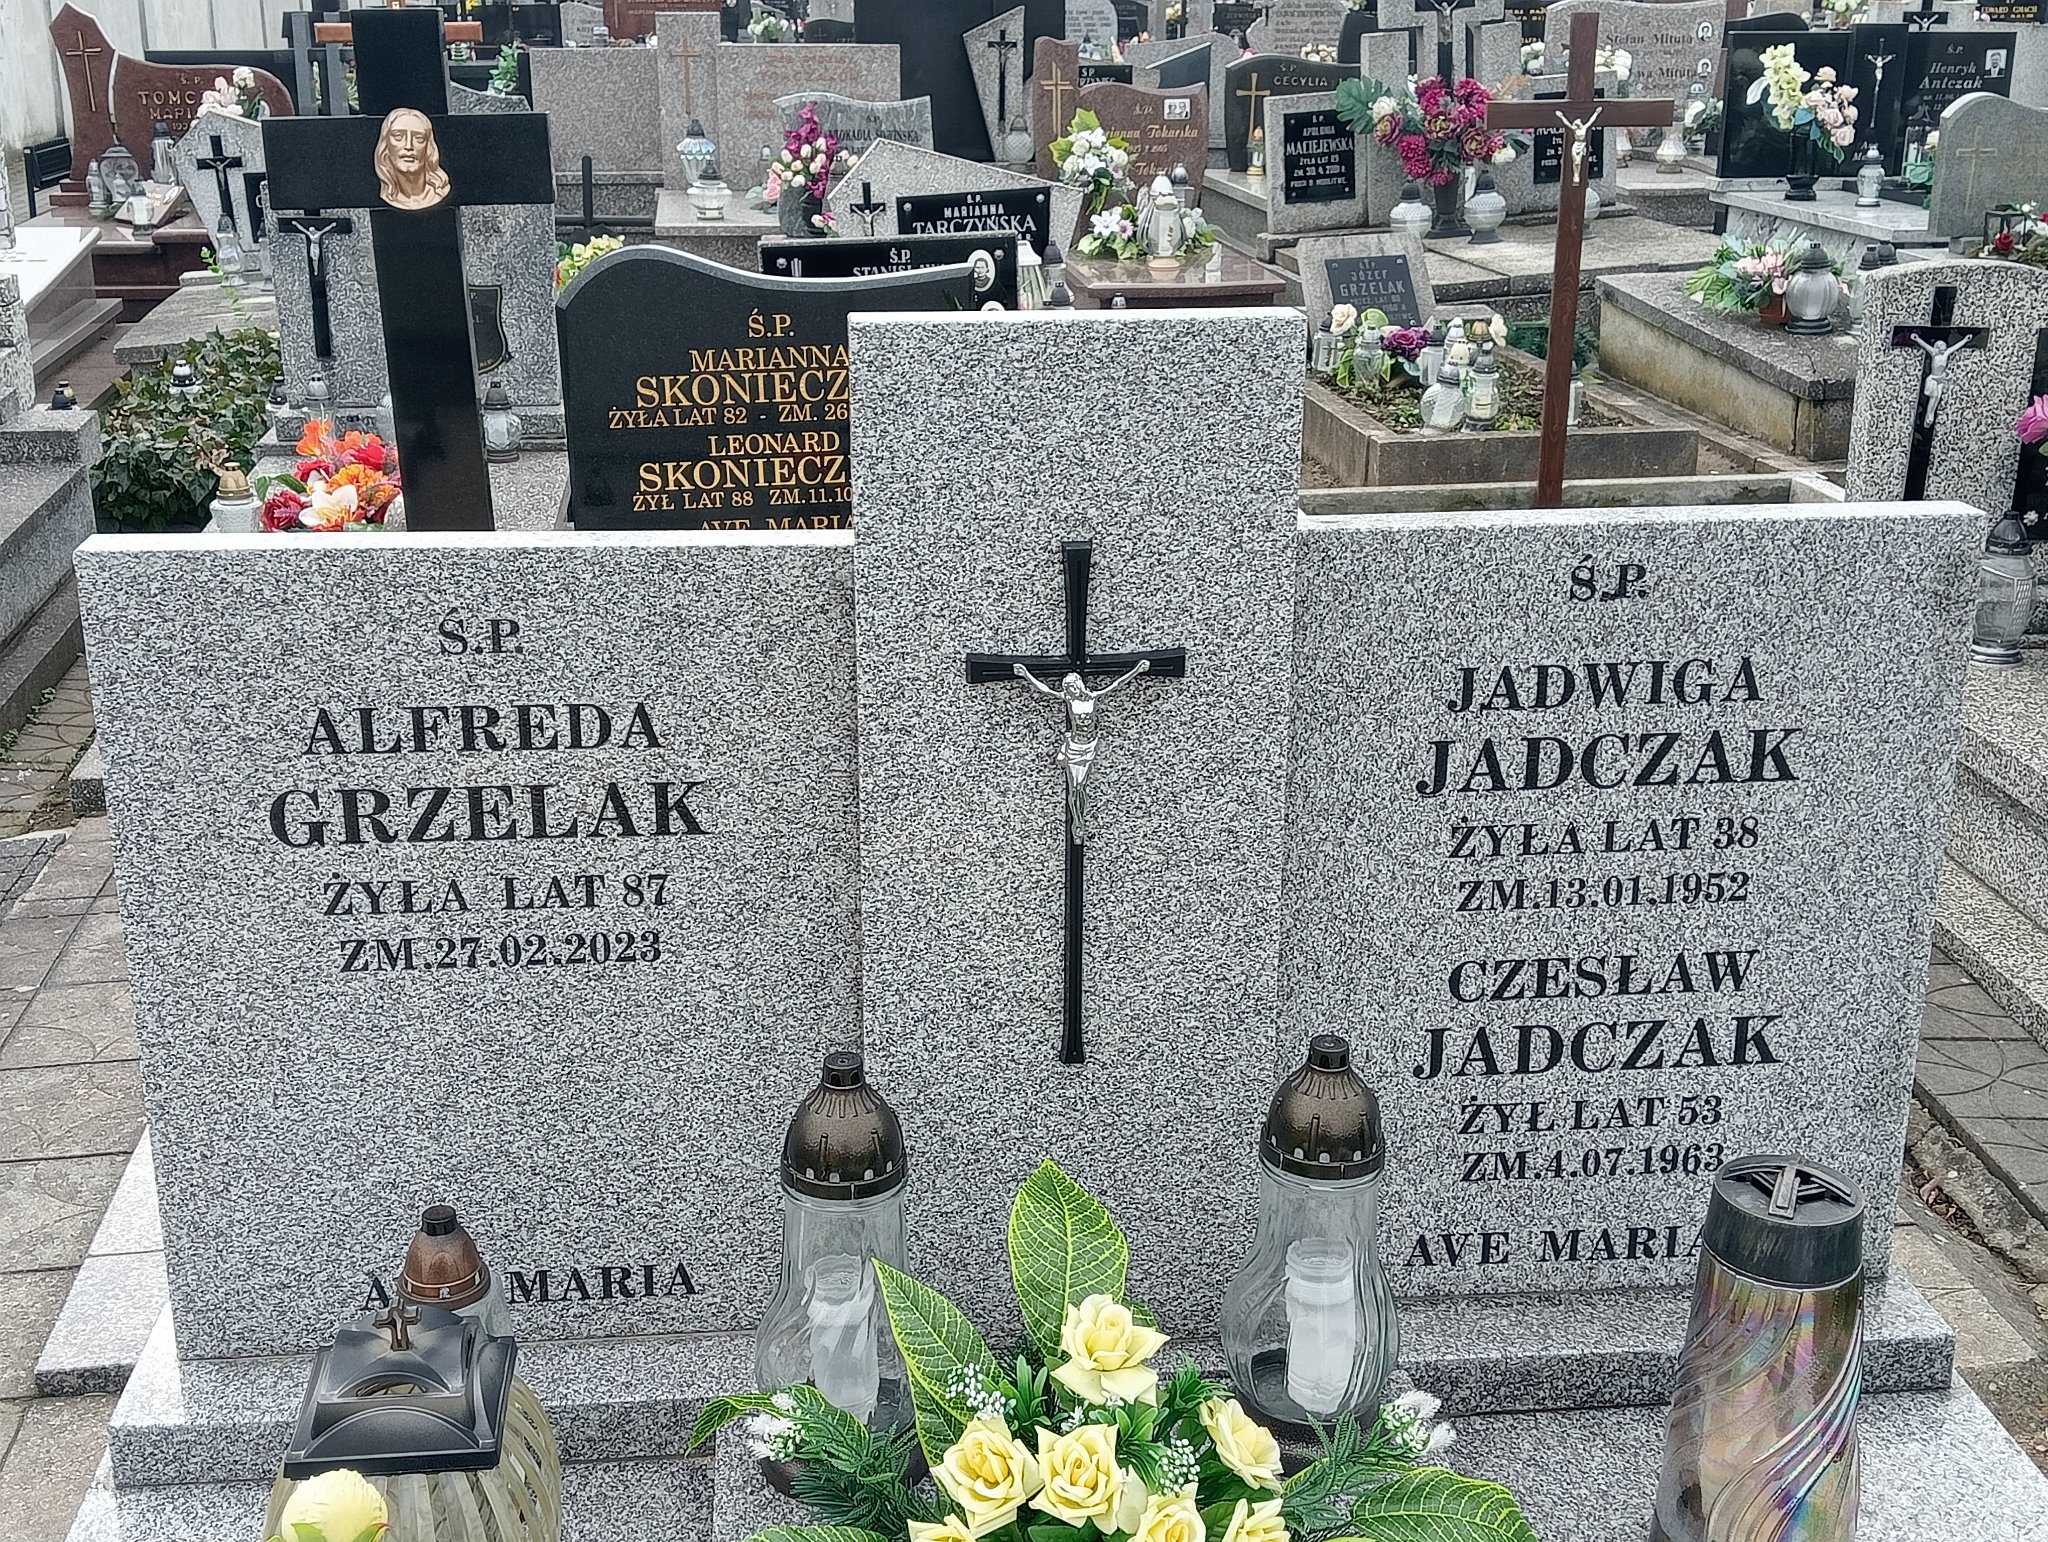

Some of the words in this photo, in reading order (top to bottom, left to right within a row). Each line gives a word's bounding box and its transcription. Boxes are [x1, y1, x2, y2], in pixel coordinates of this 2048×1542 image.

[1273, 76, 1328, 87] CECYLIA
[1918, 75, 1983, 89] Antczak
[1929, 61, 1977, 76] Henryk
[137, 90, 203, 105] TOMC
[149, 107, 198, 119] MARI
[1106, 126, 1141, 139] rianna
[1146, 124, 1199, 138] Tokarska
[1285, 137, 1355, 156] MACIEJEWSKA
[912, 214, 1037, 234] TARCZYŃSKA
[943, 203, 1005, 219] MARIANNA
[889, 247, 912, 264] Ś.P.
[1339, 280, 1406, 297] GRZELAK
[1350, 269, 1389, 281] JÓZEF
[748, 308, 796, 338] Ś.P.
[689, 344, 849, 373] MARIANNA
[636, 369, 850, 408] SKONIECZ
[608, 406, 670, 429] ŻYŁA
[672, 407, 717, 427] LAT
[723, 407, 748, 424] 82
[778, 404, 818, 423] ZM.
[824, 402, 850, 420] 26
[707, 431, 840, 457] LEONARD
[638, 454, 853, 492] SKONIECZ
[632, 490, 675, 512] ŻYŁ
[683, 491, 725, 509] LAT
[730, 491, 754, 507] 88
[769, 486, 852, 505] ZM.11.10
[1570, 554, 1647, 600] Ś.P.
[438, 607, 524, 656] Ś.P.
[1447, 656, 1763, 713] JADWIGA
[304, 702, 666, 754] ALFREDA
[1415, 728, 1801, 796] JADCZAK
[269, 780, 712, 848] GRZELAK
[1447, 815, 1585, 858] ŻYŁA
[1602, 817, 1700, 854] LAT
[1712, 816, 1760, 850] 38
[323, 872, 471, 916] ŻYŁA
[502, 873, 607, 911] LAT
[621, 873, 669, 907] 87
[1455, 871, 1751, 912] ZM.13.01.1952
[340, 930, 662, 973] ZM.27.02.2023
[1447, 949, 1760, 1001] CZESŁAW
[1412, 1014, 1783, 1080] JADCZAK
[1457, 1095, 1556, 1135] ŻYŁ
[1570, 1098, 1667, 1131] LAT
[1679, 1095, 1723, 1126] 53
[1460, 1142, 1725, 1182] ZM.4.07.1963
[1402, 1230, 1510, 1267] AVE
[505, 1261, 700, 1304] MARIA
